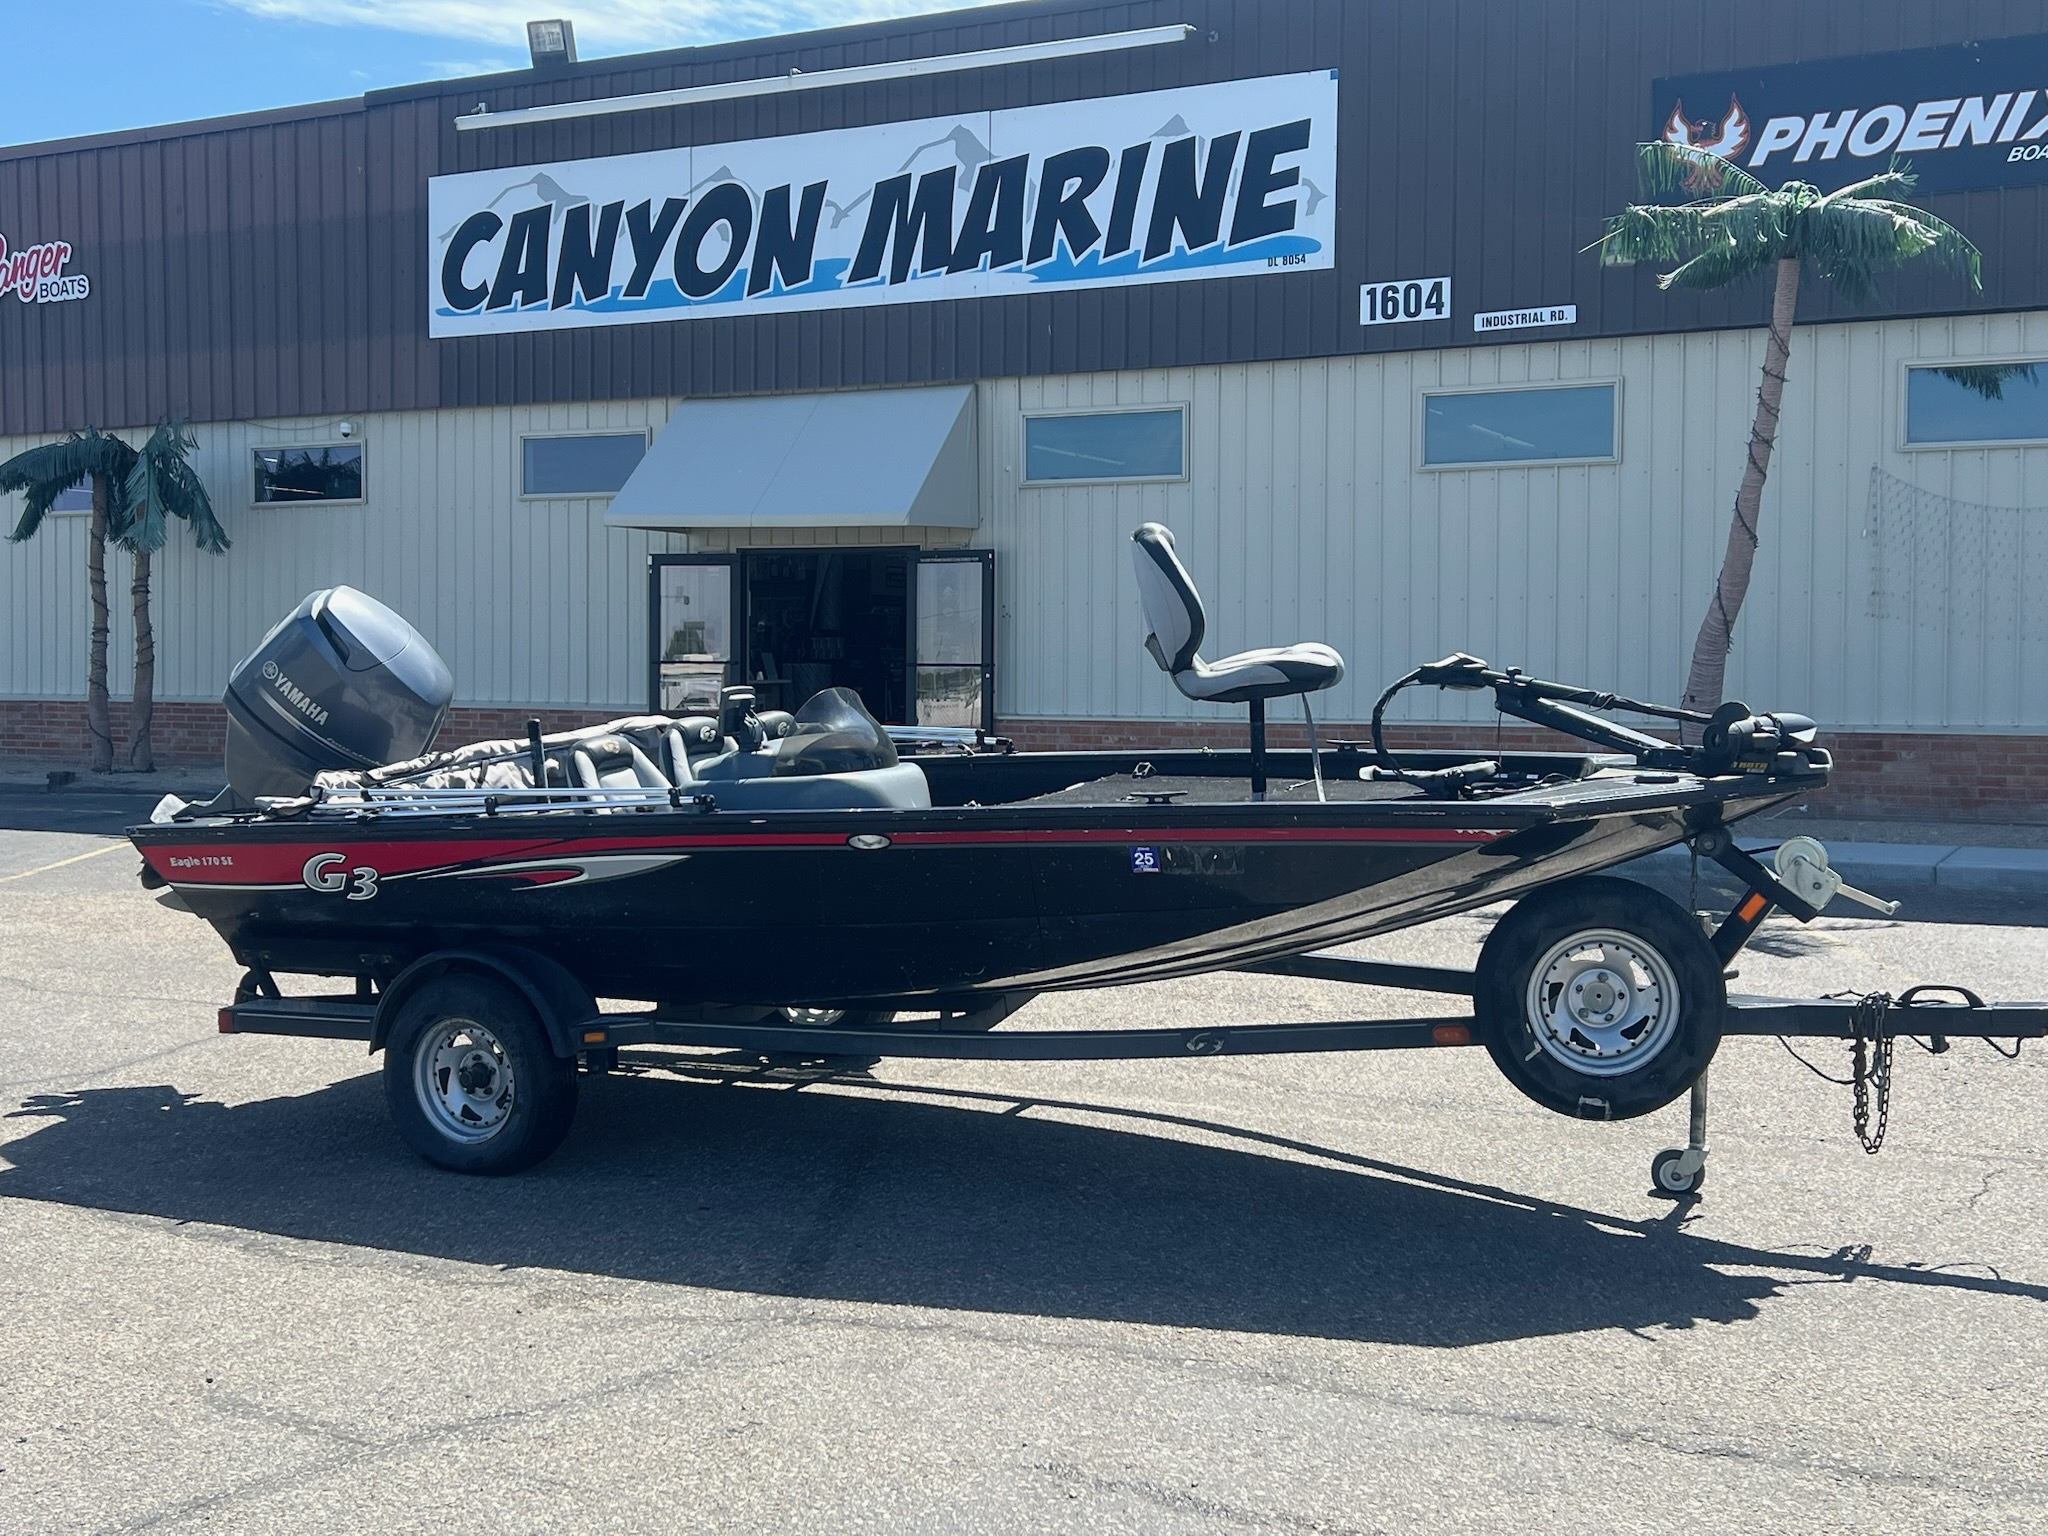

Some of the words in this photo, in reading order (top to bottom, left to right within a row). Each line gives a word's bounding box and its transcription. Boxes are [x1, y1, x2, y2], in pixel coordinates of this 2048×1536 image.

[441, 179, 829, 312] CANYON
[848, 117, 1312, 284] MARINE
[0, 236, 69, 298] anger
[1267, 256, 1279, 267] DL
[1282, 253, 1306, 266] 8054
[40, 278, 87, 298] BOATS
[1366, 281, 1445, 321] 1604
[1481, 311, 1546, 328] INDUSTRIAL
[1550, 309, 1568, 322] RD.
[274, 671, 330, 726] YAMAHA
[169, 856, 201, 868] Eagle
[202, 856, 220, 866] 170
[220, 856, 234, 866] SE
[1133, 852, 1154, 866] 25
[302, 852, 378, 901] G3
